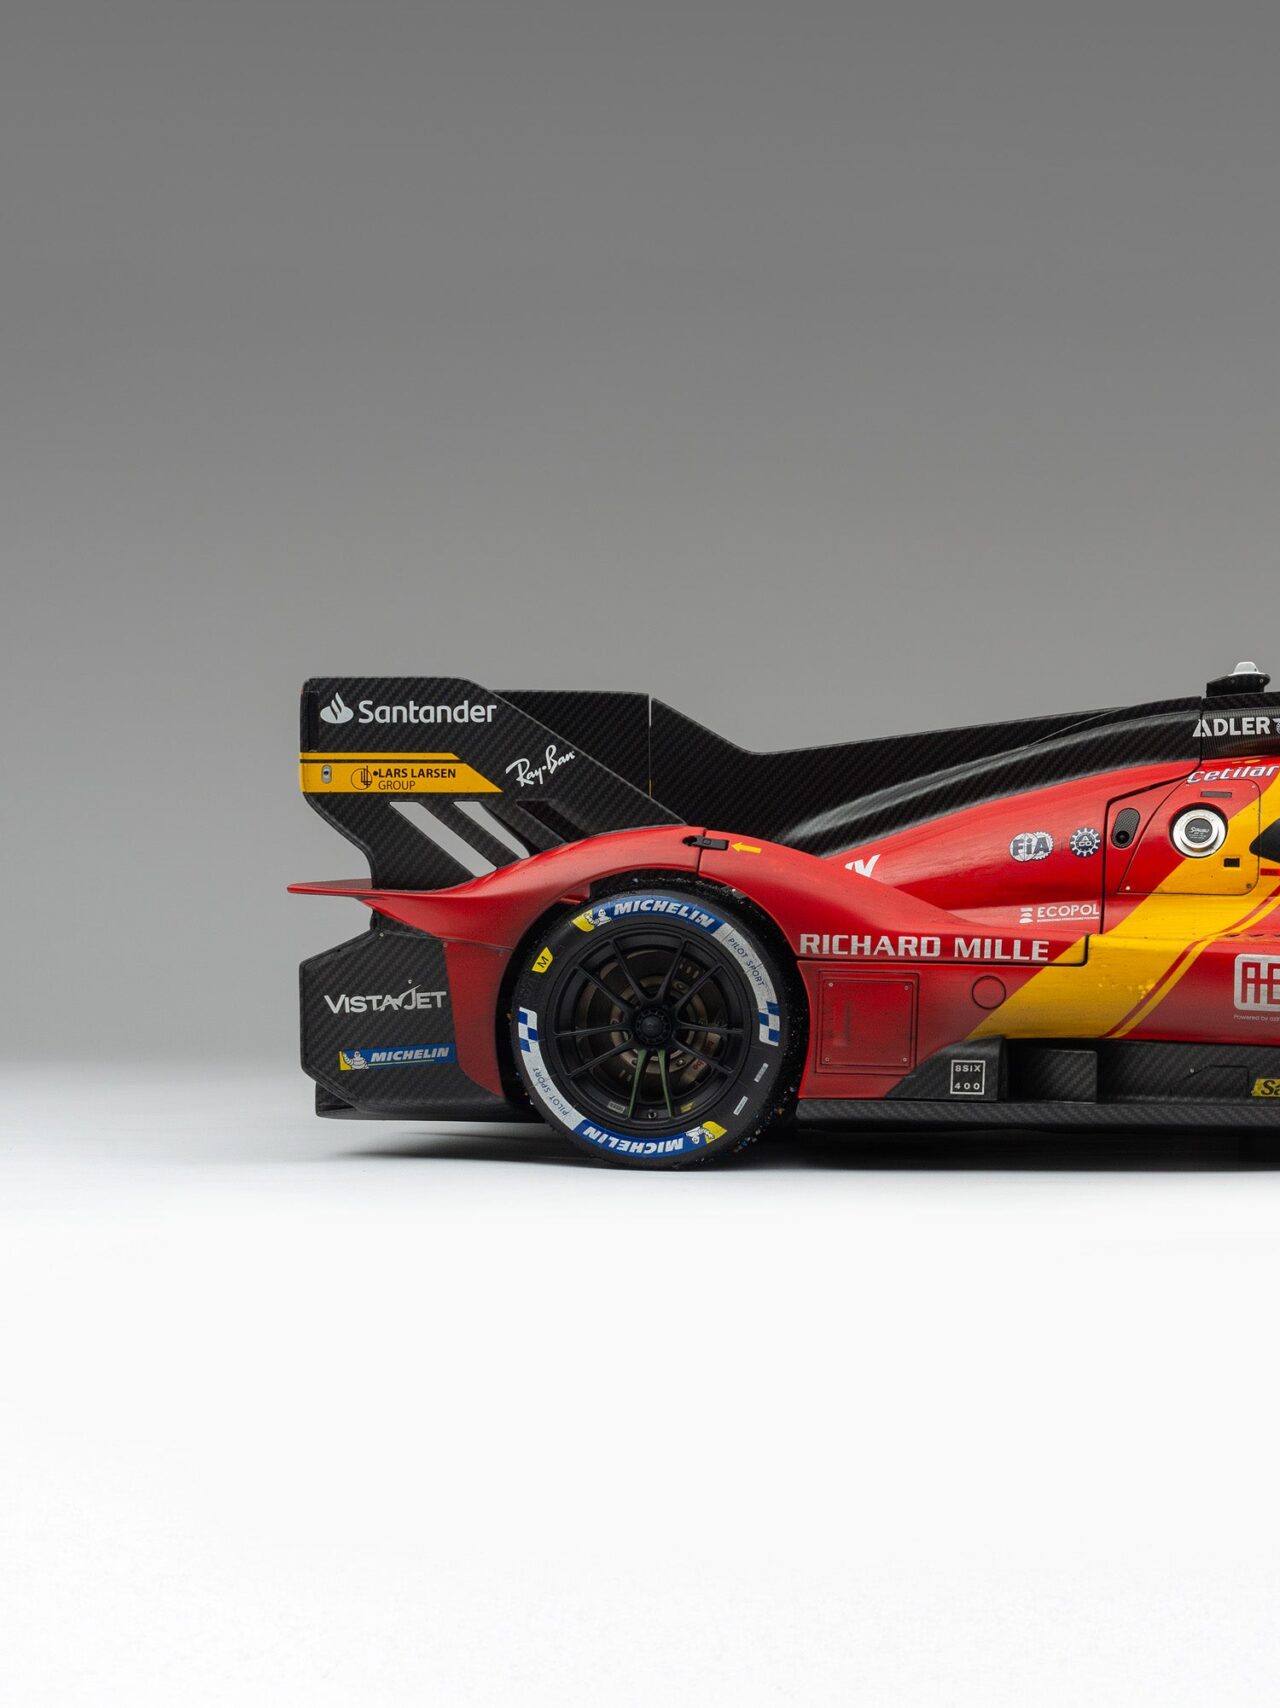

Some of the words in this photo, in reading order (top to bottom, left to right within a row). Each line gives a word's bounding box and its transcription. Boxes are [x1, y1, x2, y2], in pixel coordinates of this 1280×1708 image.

[358, 700, 497, 723] Santander
[1192, 716, 1271, 737] ADLER
[378, 768, 408, 778] LARS
[411, 768, 456, 778] LARSEN
[505, 744, 576, 787] Ray-Ban
[378, 780, 416, 790] GROUP
[614, 899, 716, 928] MICHELIN
[1037, 904, 1100, 918] ECOPOL
[800, 933, 941, 957] RICHARD
[954, 937, 1049, 961] MILLE
[537, 955, 549, 969] M
[728, 937, 749, 959] PILOT
[745, 959, 766, 988] SPORT
[371, 1047, 450, 1062] MICHELIN
[532, 1067, 552, 1094] SPORT
[549, 1095, 570, 1118] PILOT
[583, 1125, 685, 1155] MICHELIN
